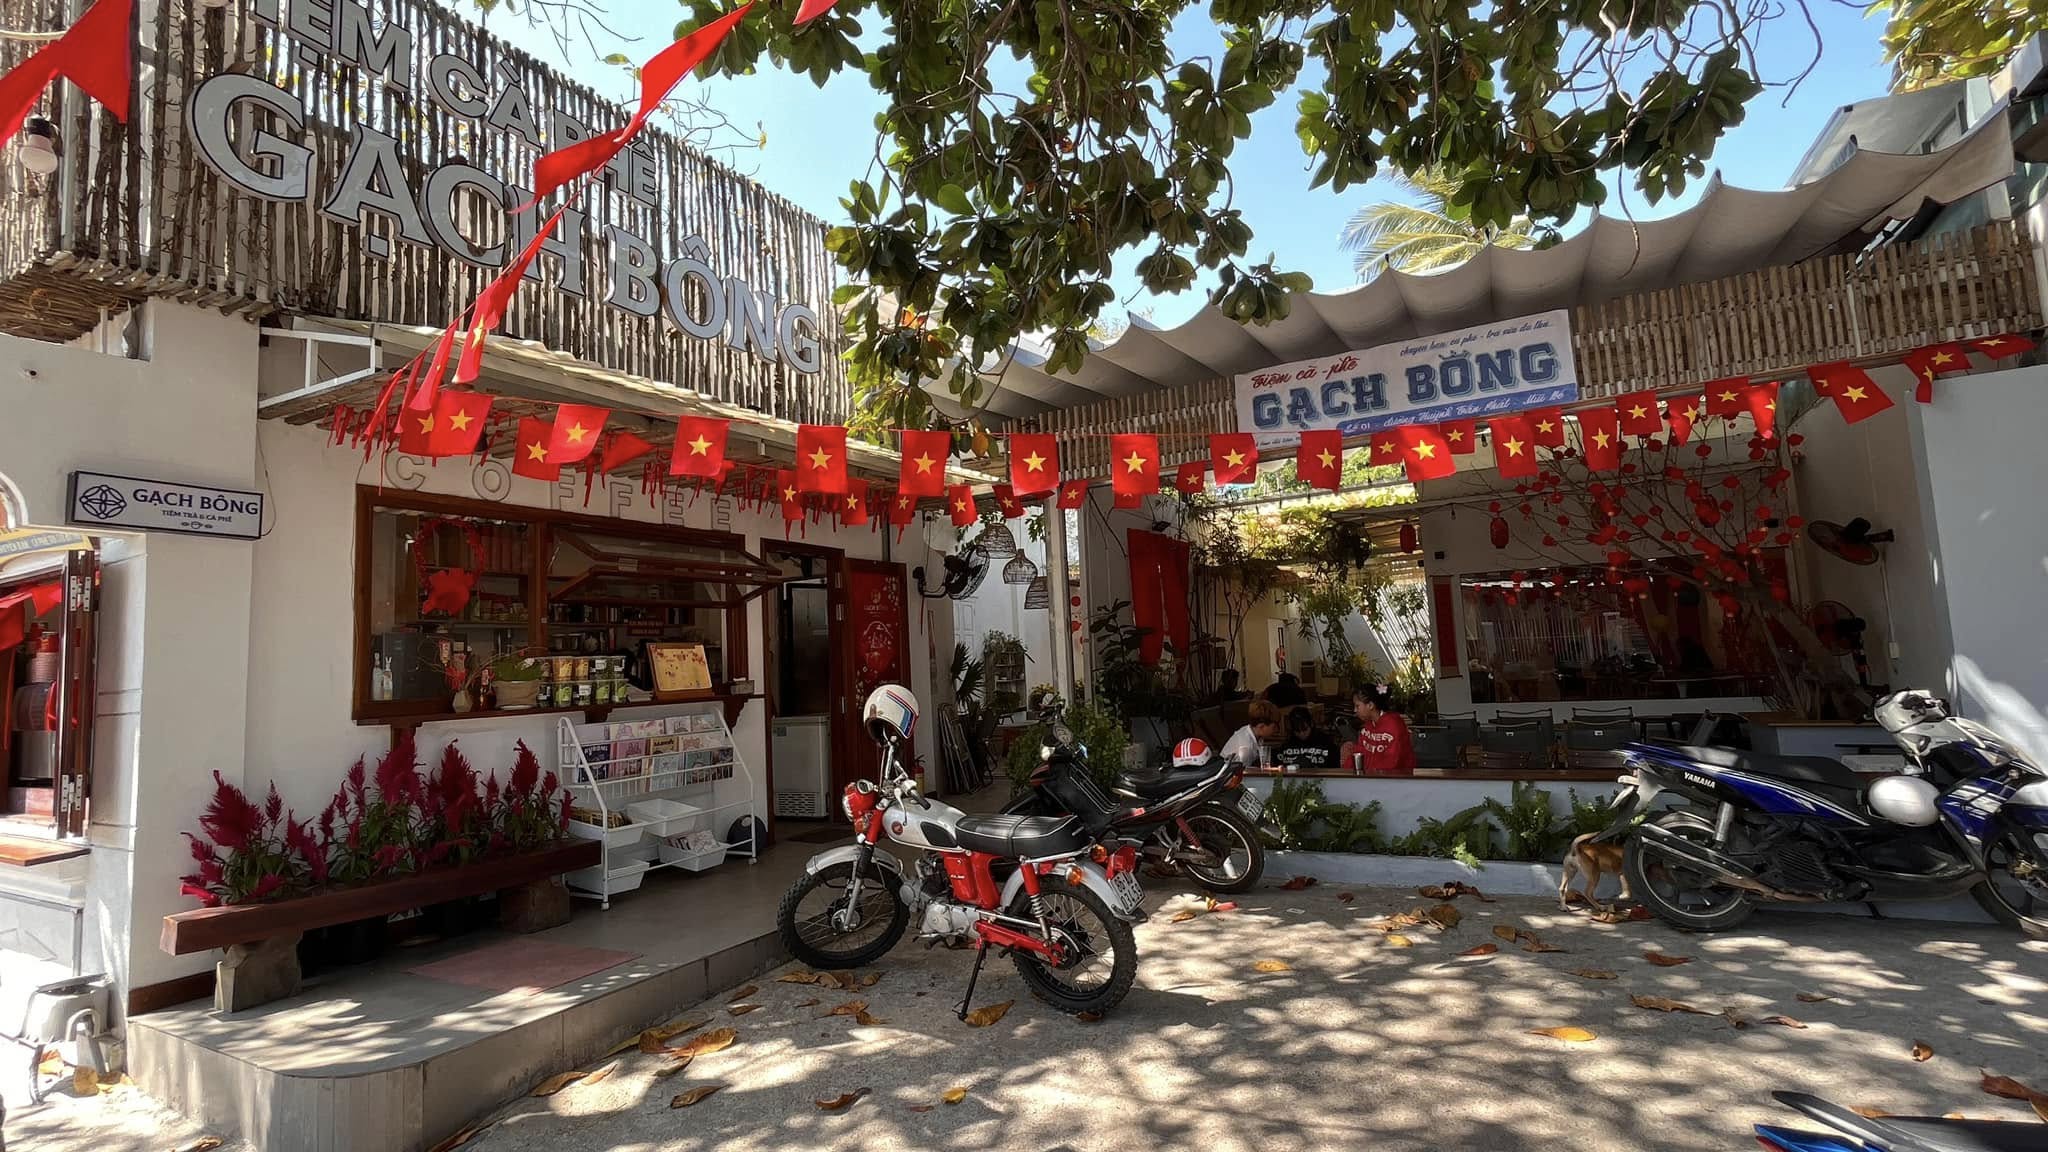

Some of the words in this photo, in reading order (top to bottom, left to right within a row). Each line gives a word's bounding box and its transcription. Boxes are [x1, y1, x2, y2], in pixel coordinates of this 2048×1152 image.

[426, 58, 543, 151] CÀ
[186, 72, 587, 299] GẠCH
[604, 224, 820, 375] BÔNG
[1252, 373, 1389, 430] GẠCH
[132, 488, 193, 508] GẠCH
[200, 494, 258, 515] BÔNG
[384, 448, 731, 532] COFFEE
[1684, 771, 1716, 789] YAMAHA
